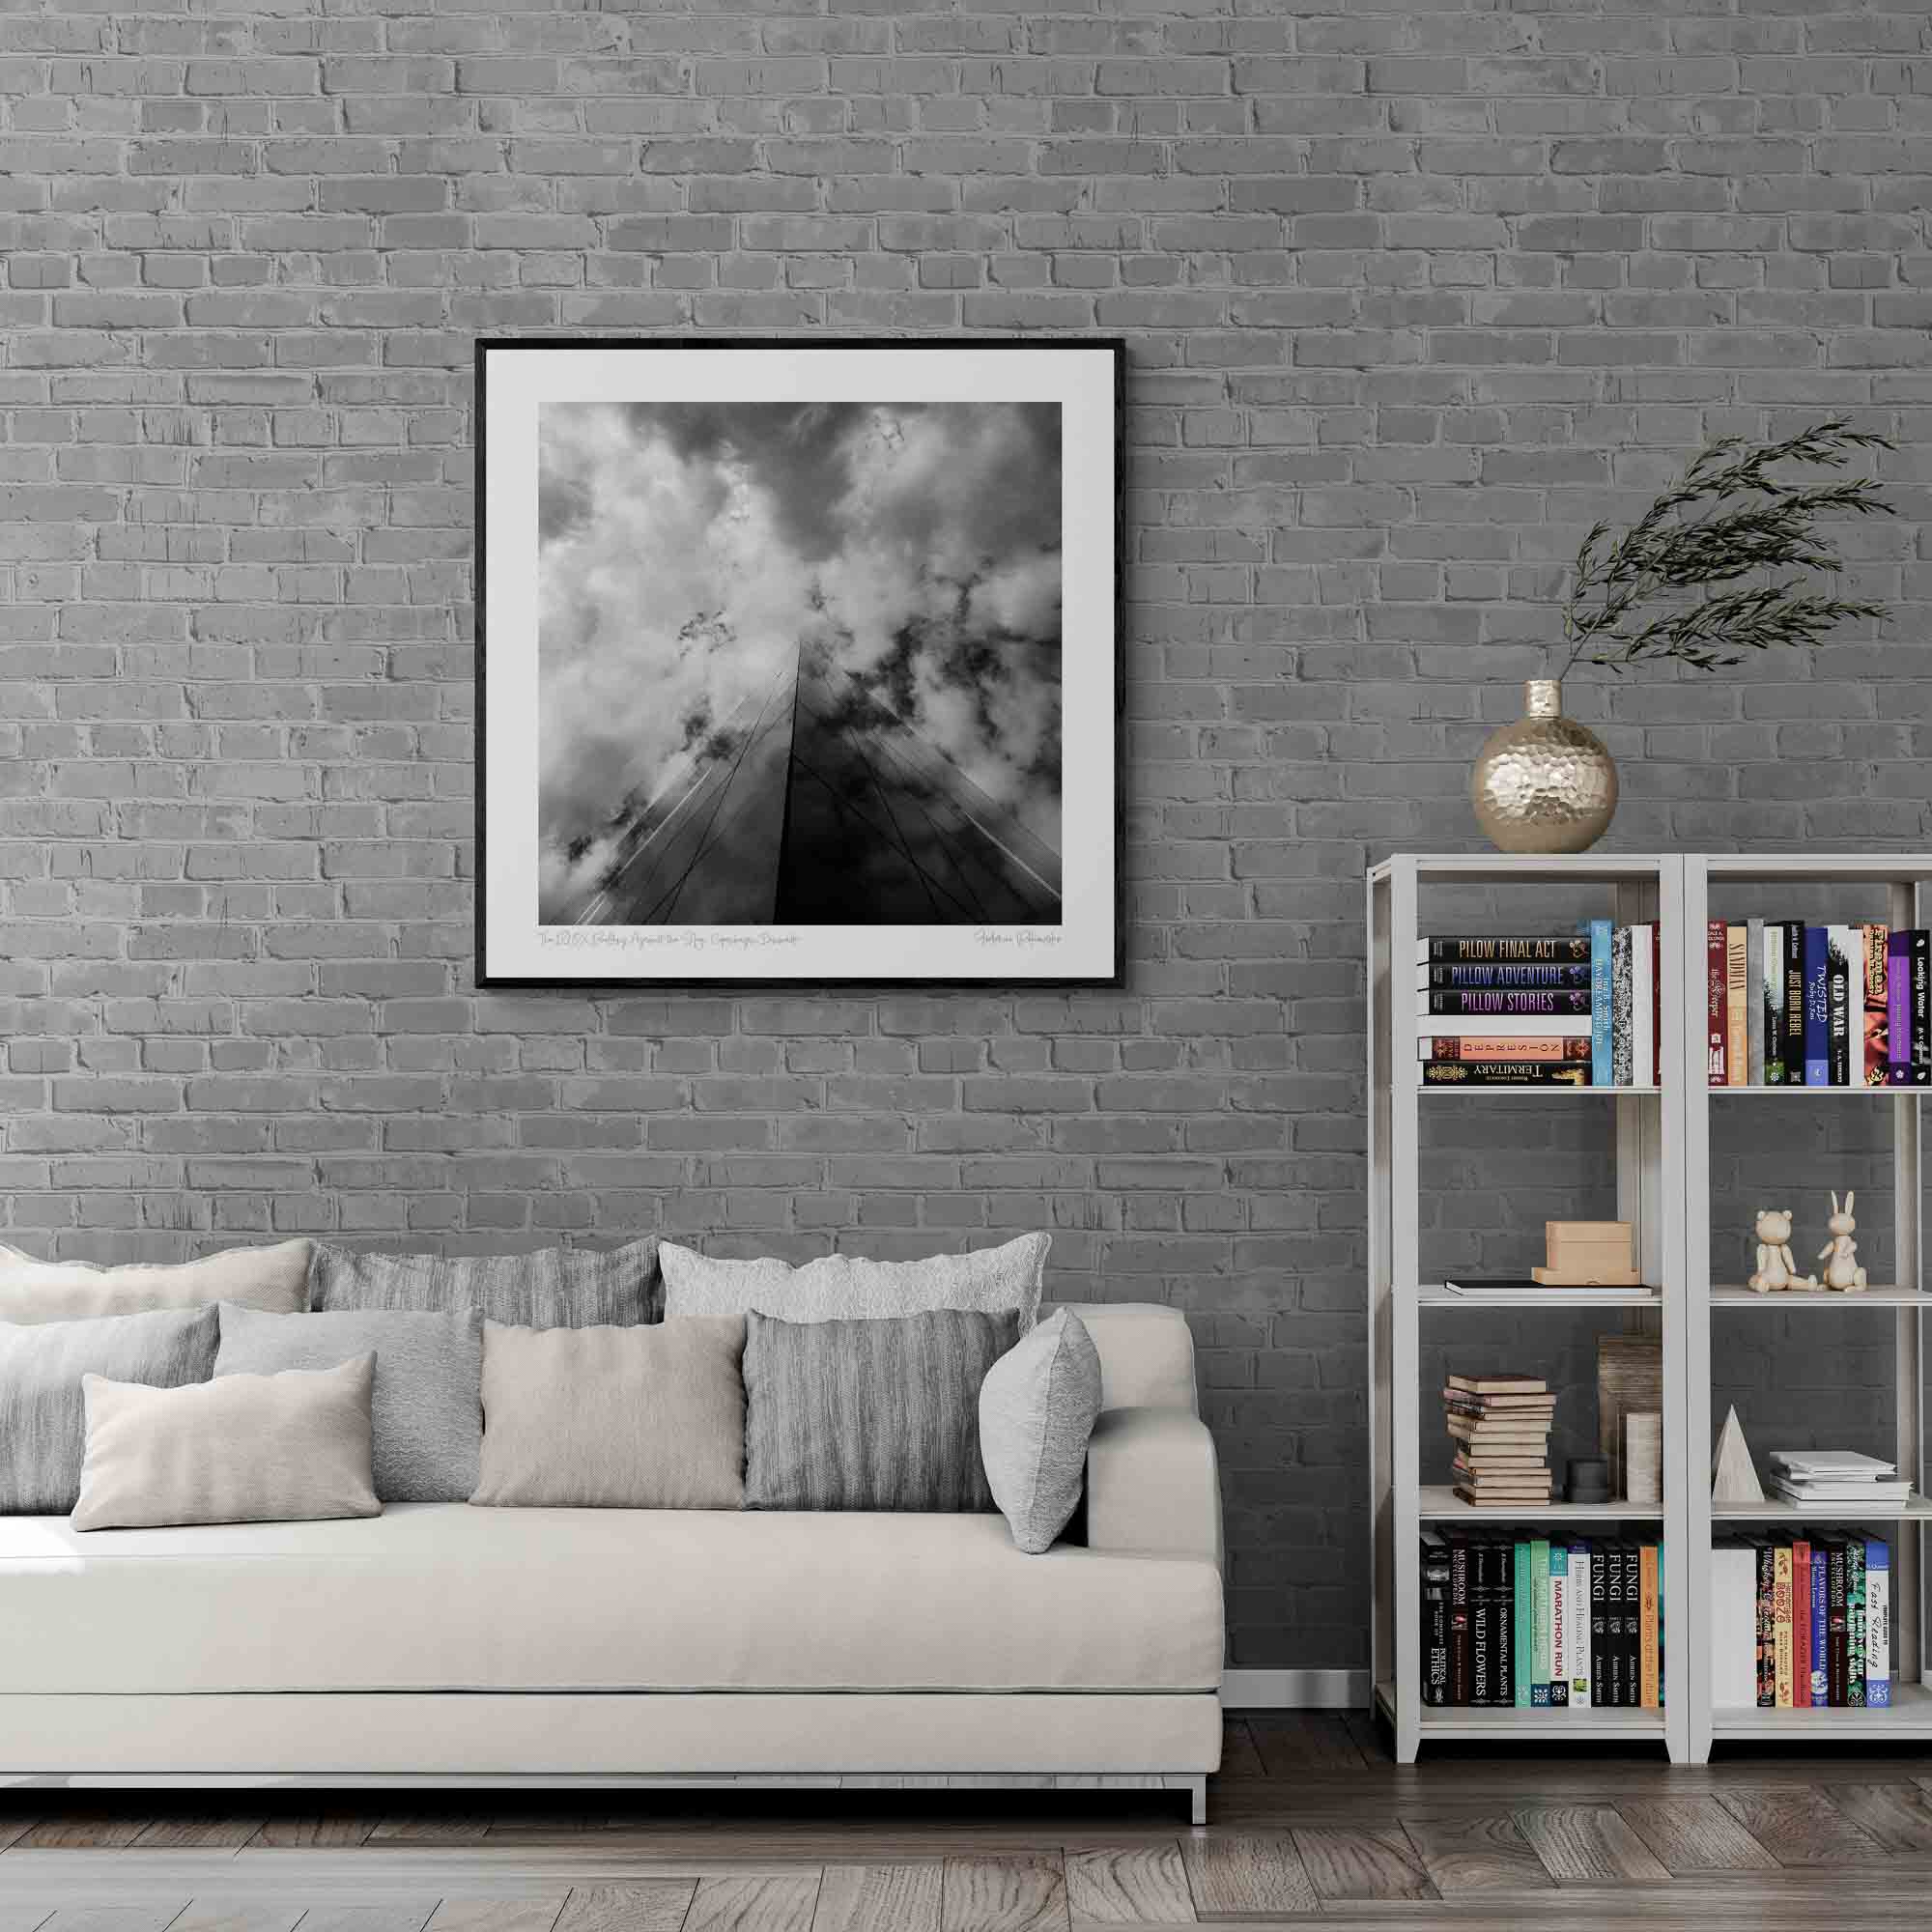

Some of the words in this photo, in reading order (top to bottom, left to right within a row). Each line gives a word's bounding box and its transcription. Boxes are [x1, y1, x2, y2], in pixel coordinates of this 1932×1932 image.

[1460, 941, 1494, 958] PILOW
[1499, 941, 1531, 957] FINAL
[1535, 941, 1555, 957] ACT
[1874, 929, 1885, 994] Fireman
[1452, 967, 1492, 984] PILLOW
[1498, 967, 1563, 984] ADVENTURE
[1729, 944, 1746, 989] SANDMAN
[1788, 970, 1801, 988] JUST
[1462, 993, 1503, 1011] PILLOW
[1508, 993, 1553, 1010] STORIES
[1789, 991, 1801, 1011] BORN
[1817, 965, 1827, 1023] TWISTED
[1833, 974, 1844, 1001] OLD
[1789, 1014, 1801, 1036] REBEL
[1833, 1006, 1844, 1036] WAR
[1473, 1065, 1543, 1077] TERMITARY
[1593, 1554, 1604, 1601] FUNGI
[1609, 1554, 1621, 1601] FUNGI
[1627, 1554, 1637, 1601] FUNGI
[1819, 1605, 1826, 1615] OF
[1870, 1583, 1881, 1609] Fast
[1475, 1608, 1486, 1638] WILD
[1554, 1580, 1563, 1648] MARATHON
[1867, 1618, 1881, 1669] Reading
[1431, 1647, 1439, 1685] ETHICS
[1475, 1641, 1486, 1695] FLOWERS
